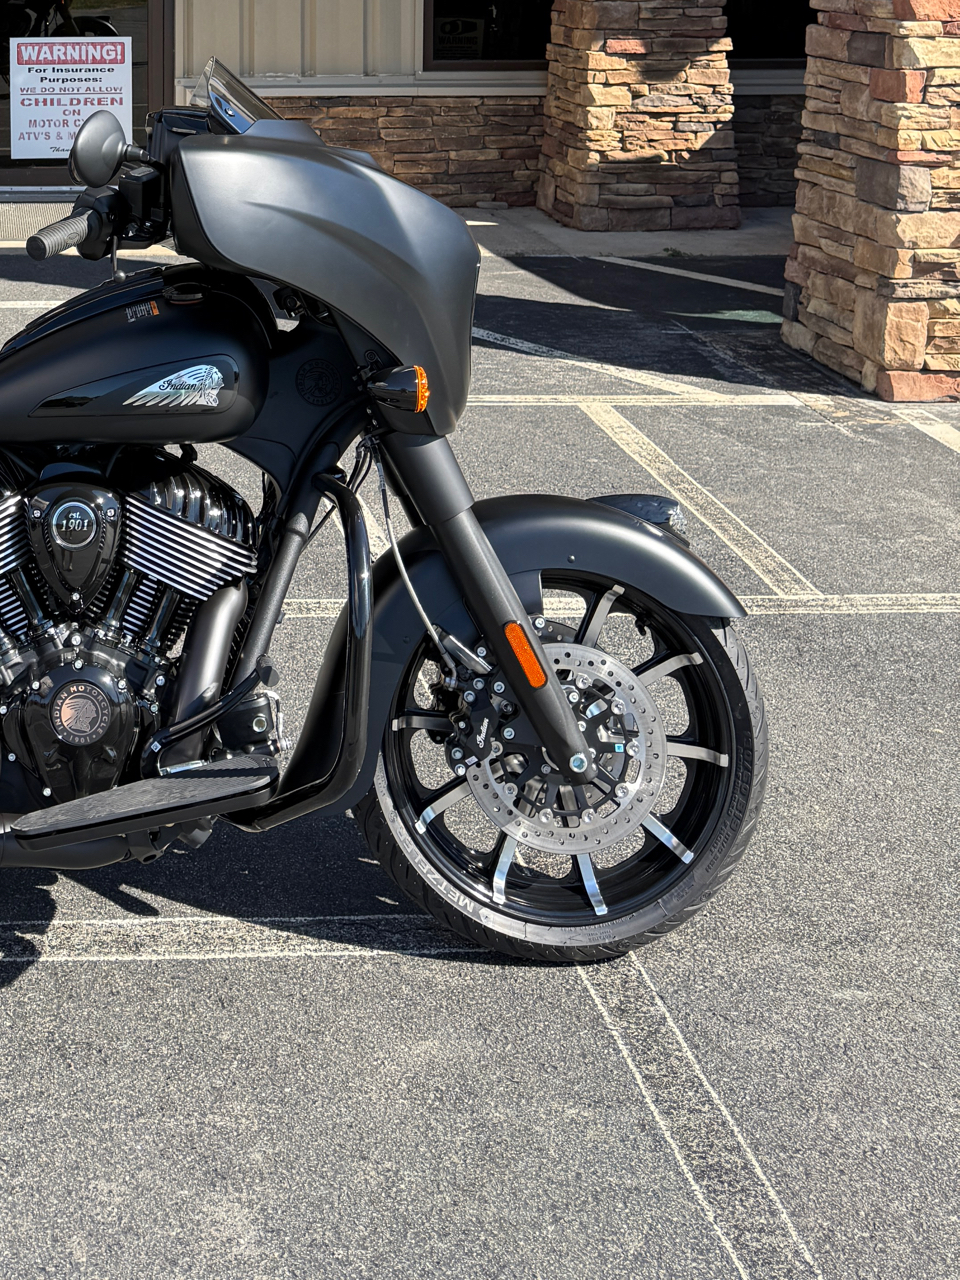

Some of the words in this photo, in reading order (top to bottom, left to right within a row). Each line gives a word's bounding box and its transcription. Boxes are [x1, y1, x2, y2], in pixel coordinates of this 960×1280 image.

[20, 45, 122, 61] WARNING!
[40, 76, 103, 84] Purposes:
[20, 97, 124, 107] CHILDREN
[28, 119, 69, 128] MOTOR
[18, 132, 51, 141] ATV'S
[55, 132, 63, 140] &
[158, 378, 198, 392] Indian
[60, 519, 89, 532] 1901
[54, 692, 68, 732] INDIAN
[70, 685, 108, 734] MOTORCYCLE
[68, 735, 91, 744] 1901
[396, 825, 475, 914] METZELER
